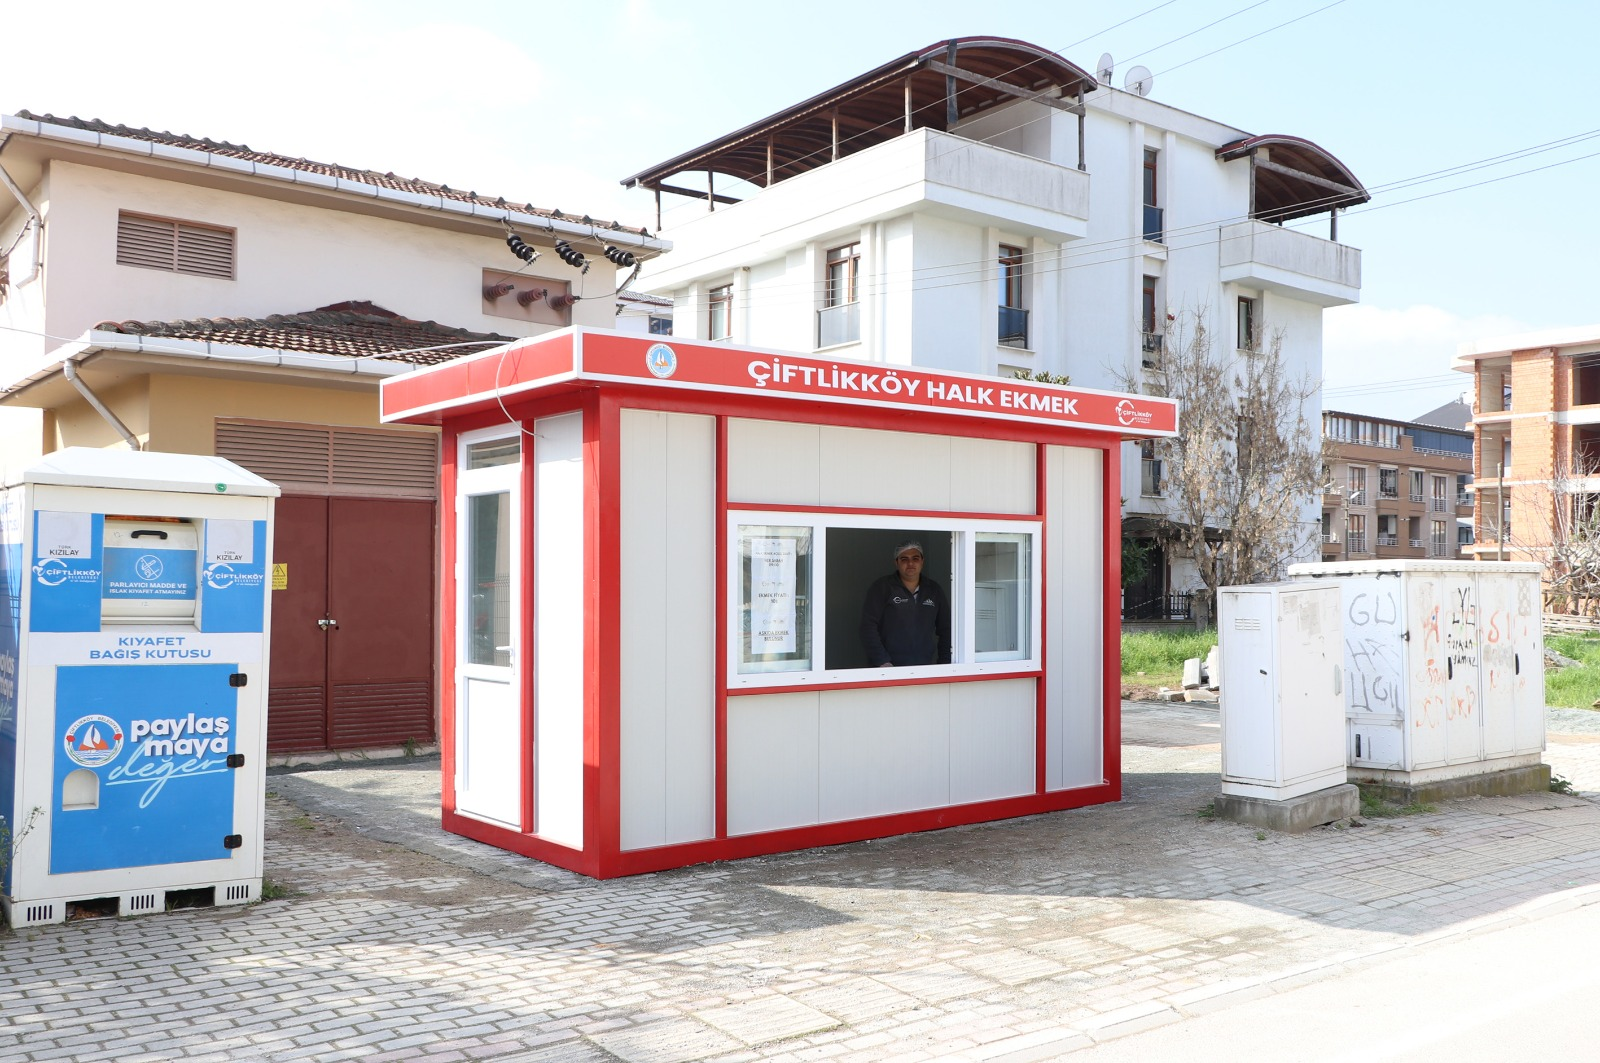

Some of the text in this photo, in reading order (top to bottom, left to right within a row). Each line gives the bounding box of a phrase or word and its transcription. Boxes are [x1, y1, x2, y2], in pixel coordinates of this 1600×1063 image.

[747, 357, 1079, 415] ÇİFTLİKKÖY HALK EKMEK
[89, 649, 211, 660] BAĞIŞ KUTUSU
[119, 637, 186, 646] KIYAFET
[130, 712, 230, 742] paylaş
[144, 736, 229, 759] maya
[107, 736, 228, 809] değer
